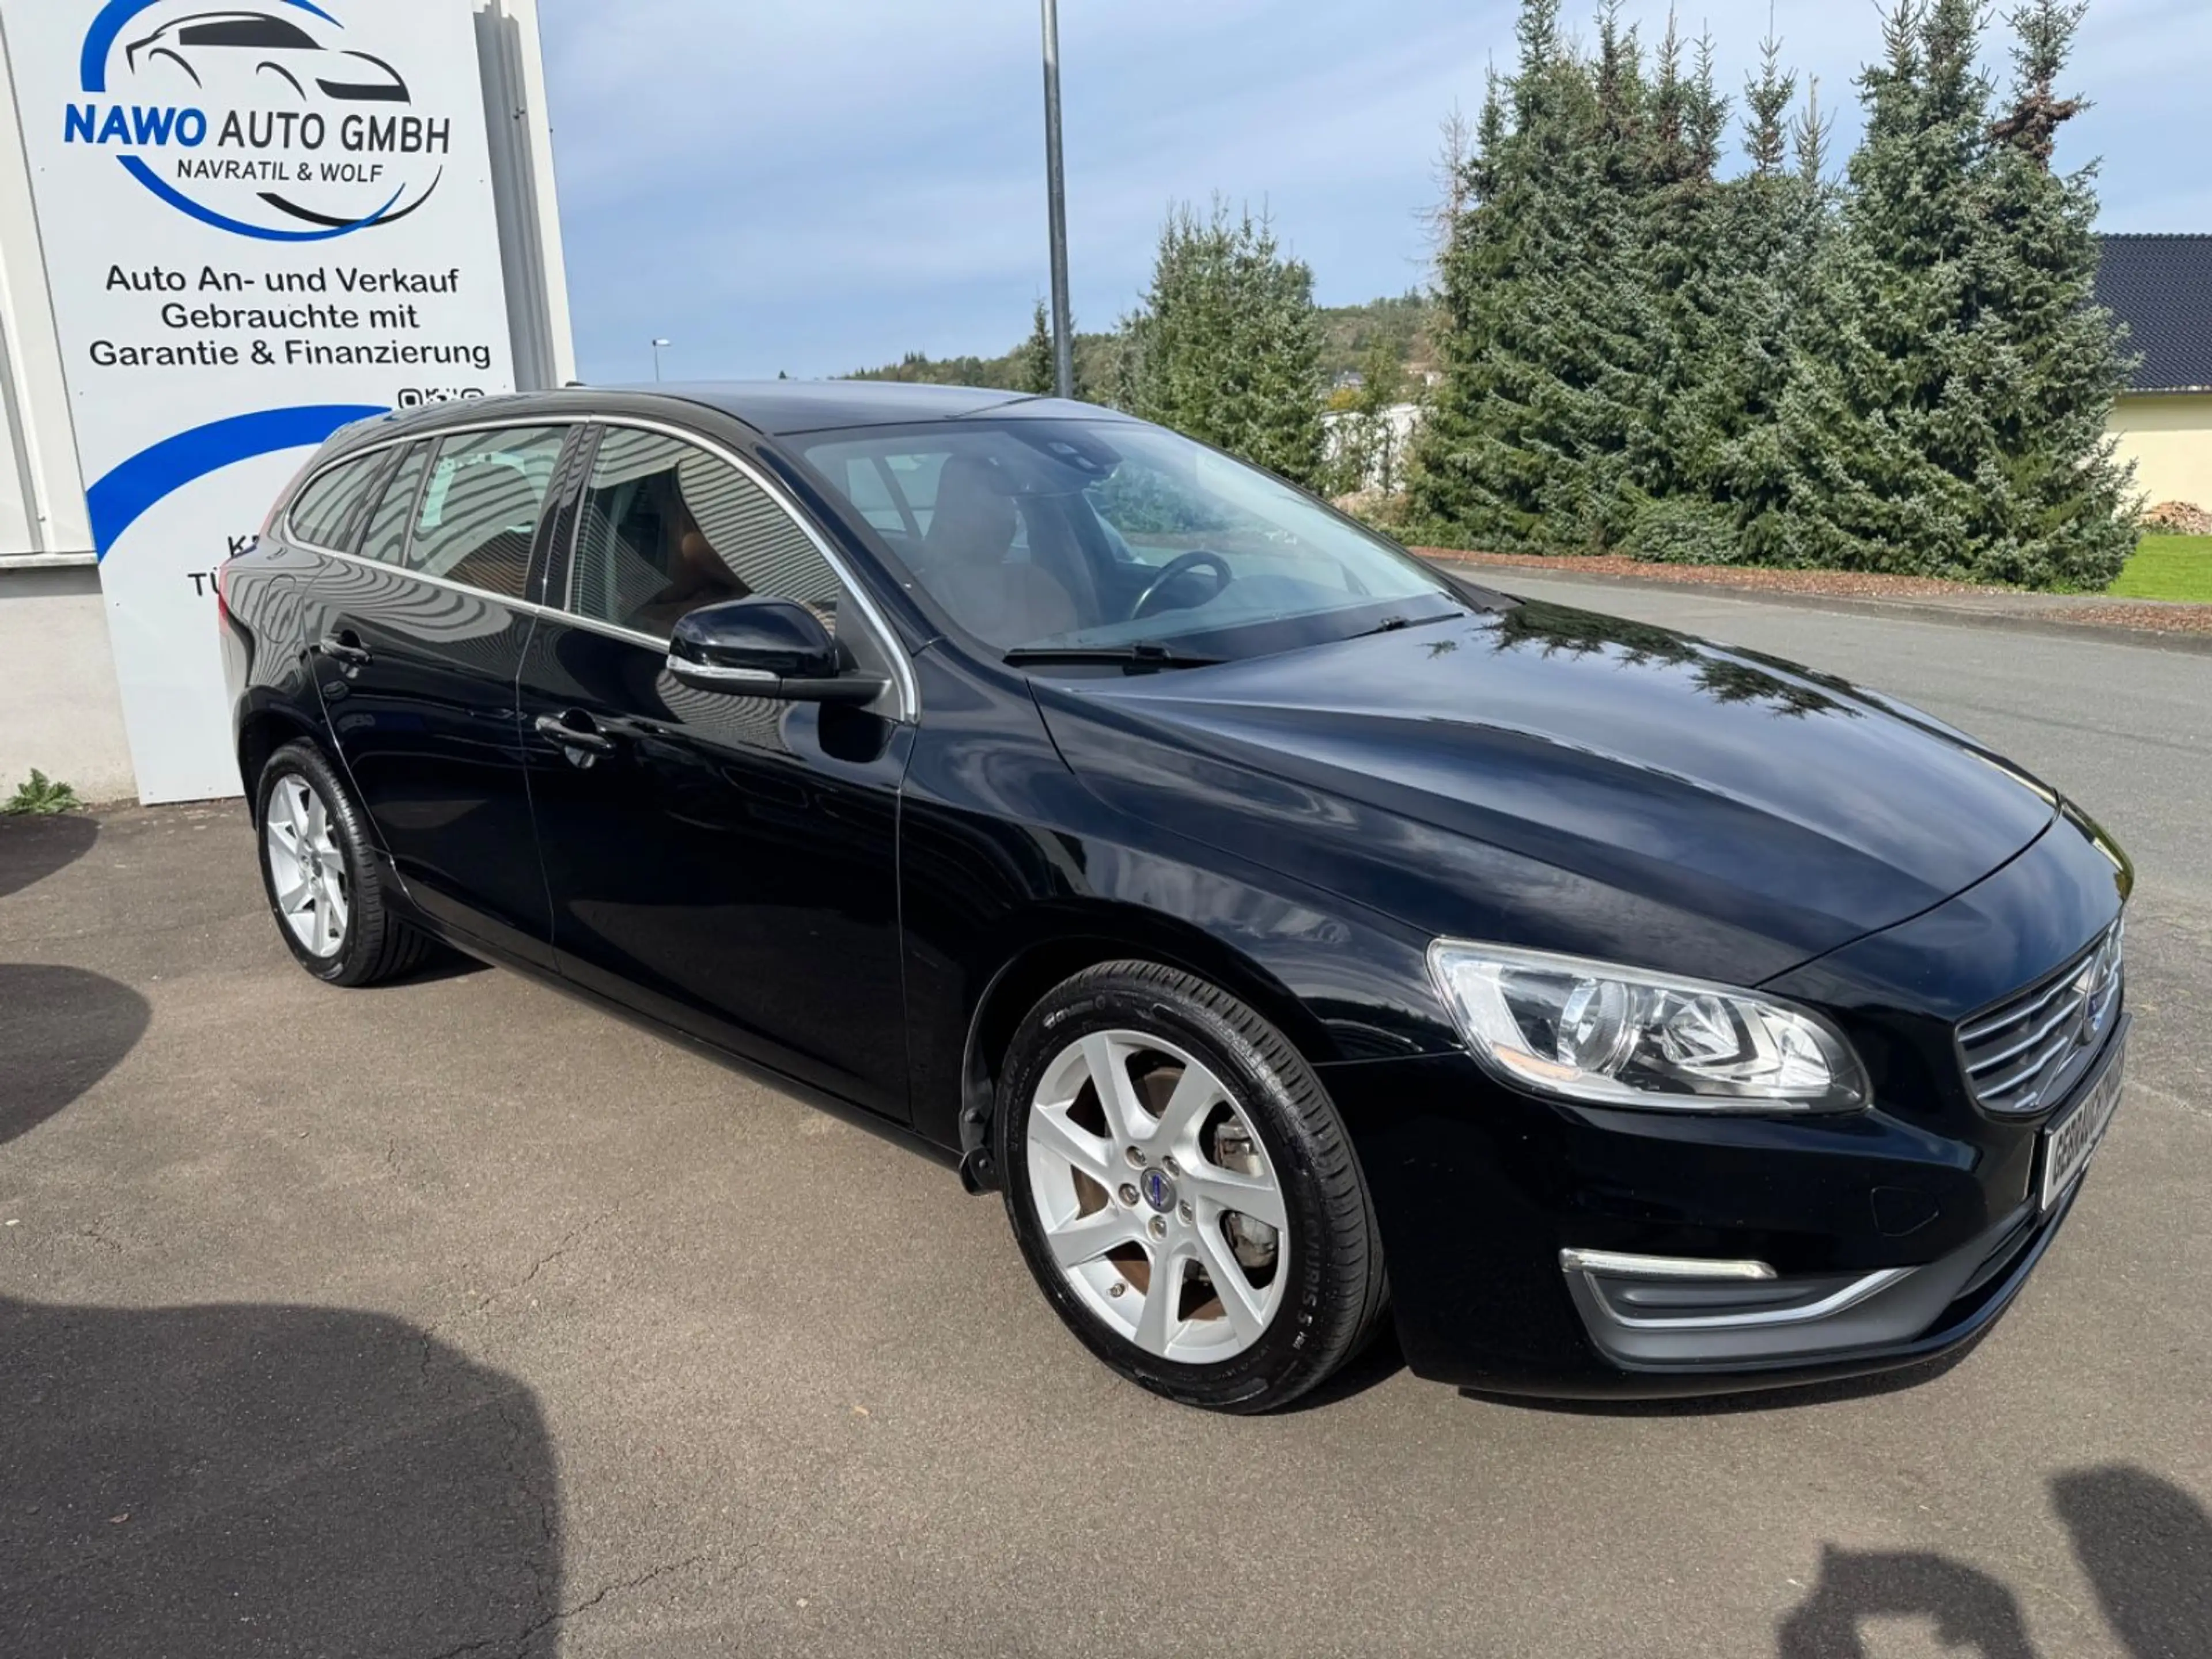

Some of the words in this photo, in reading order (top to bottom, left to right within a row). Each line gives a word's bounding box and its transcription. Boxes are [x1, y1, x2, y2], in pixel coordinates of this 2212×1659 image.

[64, 103, 207, 147] NAWO
[217, 110, 325, 150] AUTO
[340, 114, 450, 154] GMBH
[177, 158, 290, 181] NAVRATIL
[297, 162, 313, 181] &
[320, 162, 384, 183] WOLF
[106, 264, 187, 291] Auto
[198, 266, 255, 291] An-
[265, 267, 327, 292] und
[335, 267, 460, 293] Verkauf
[161, 302, 359, 328] Gebrauchte
[369, 304, 420, 328] mit
[89, 340, 239, 366] Garantie
[251, 339, 275, 365] &
[285, 339, 491, 370] Finanzierung
[228, 535, 259, 558] K
